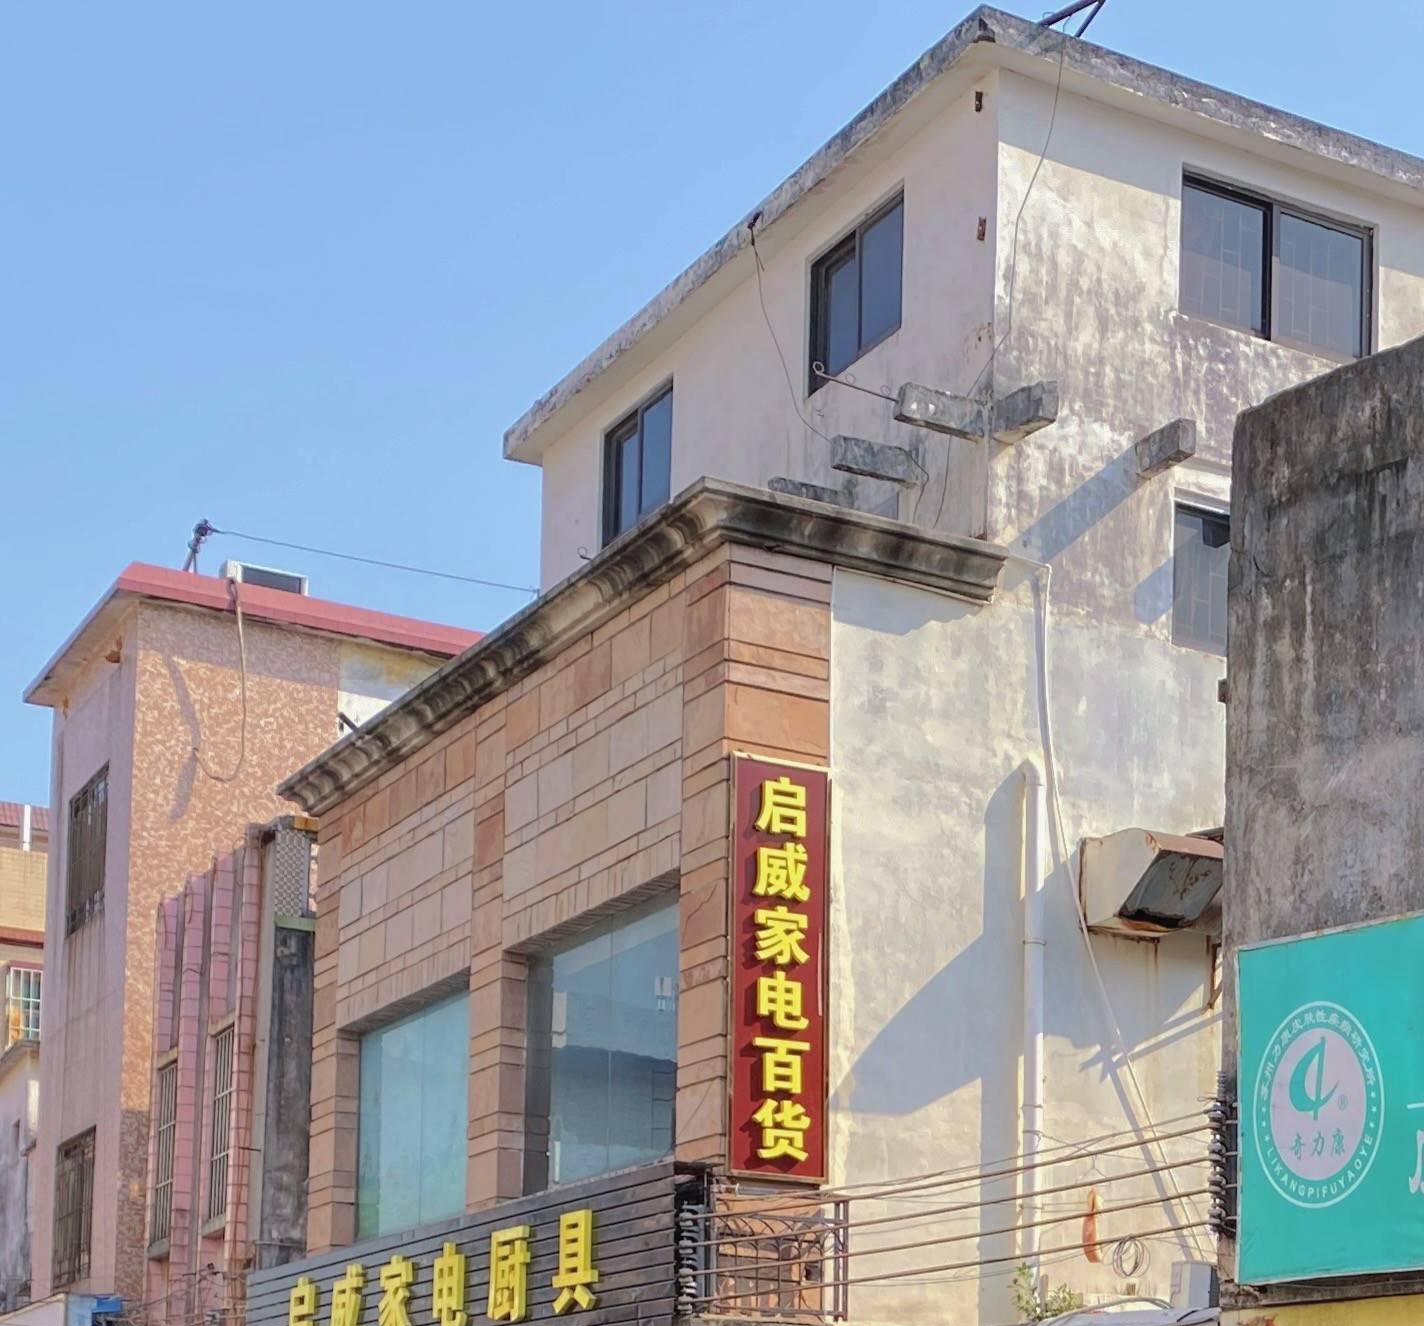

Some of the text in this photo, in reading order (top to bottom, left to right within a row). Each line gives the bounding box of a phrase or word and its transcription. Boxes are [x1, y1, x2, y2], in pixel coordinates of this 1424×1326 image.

[754, 776, 811, 1161] 启威家电百货
[1265, 1135, 1375, 1200] LIKANGPIFUYAOYE
[1289, 1126, 1347, 1161] 奇力康
